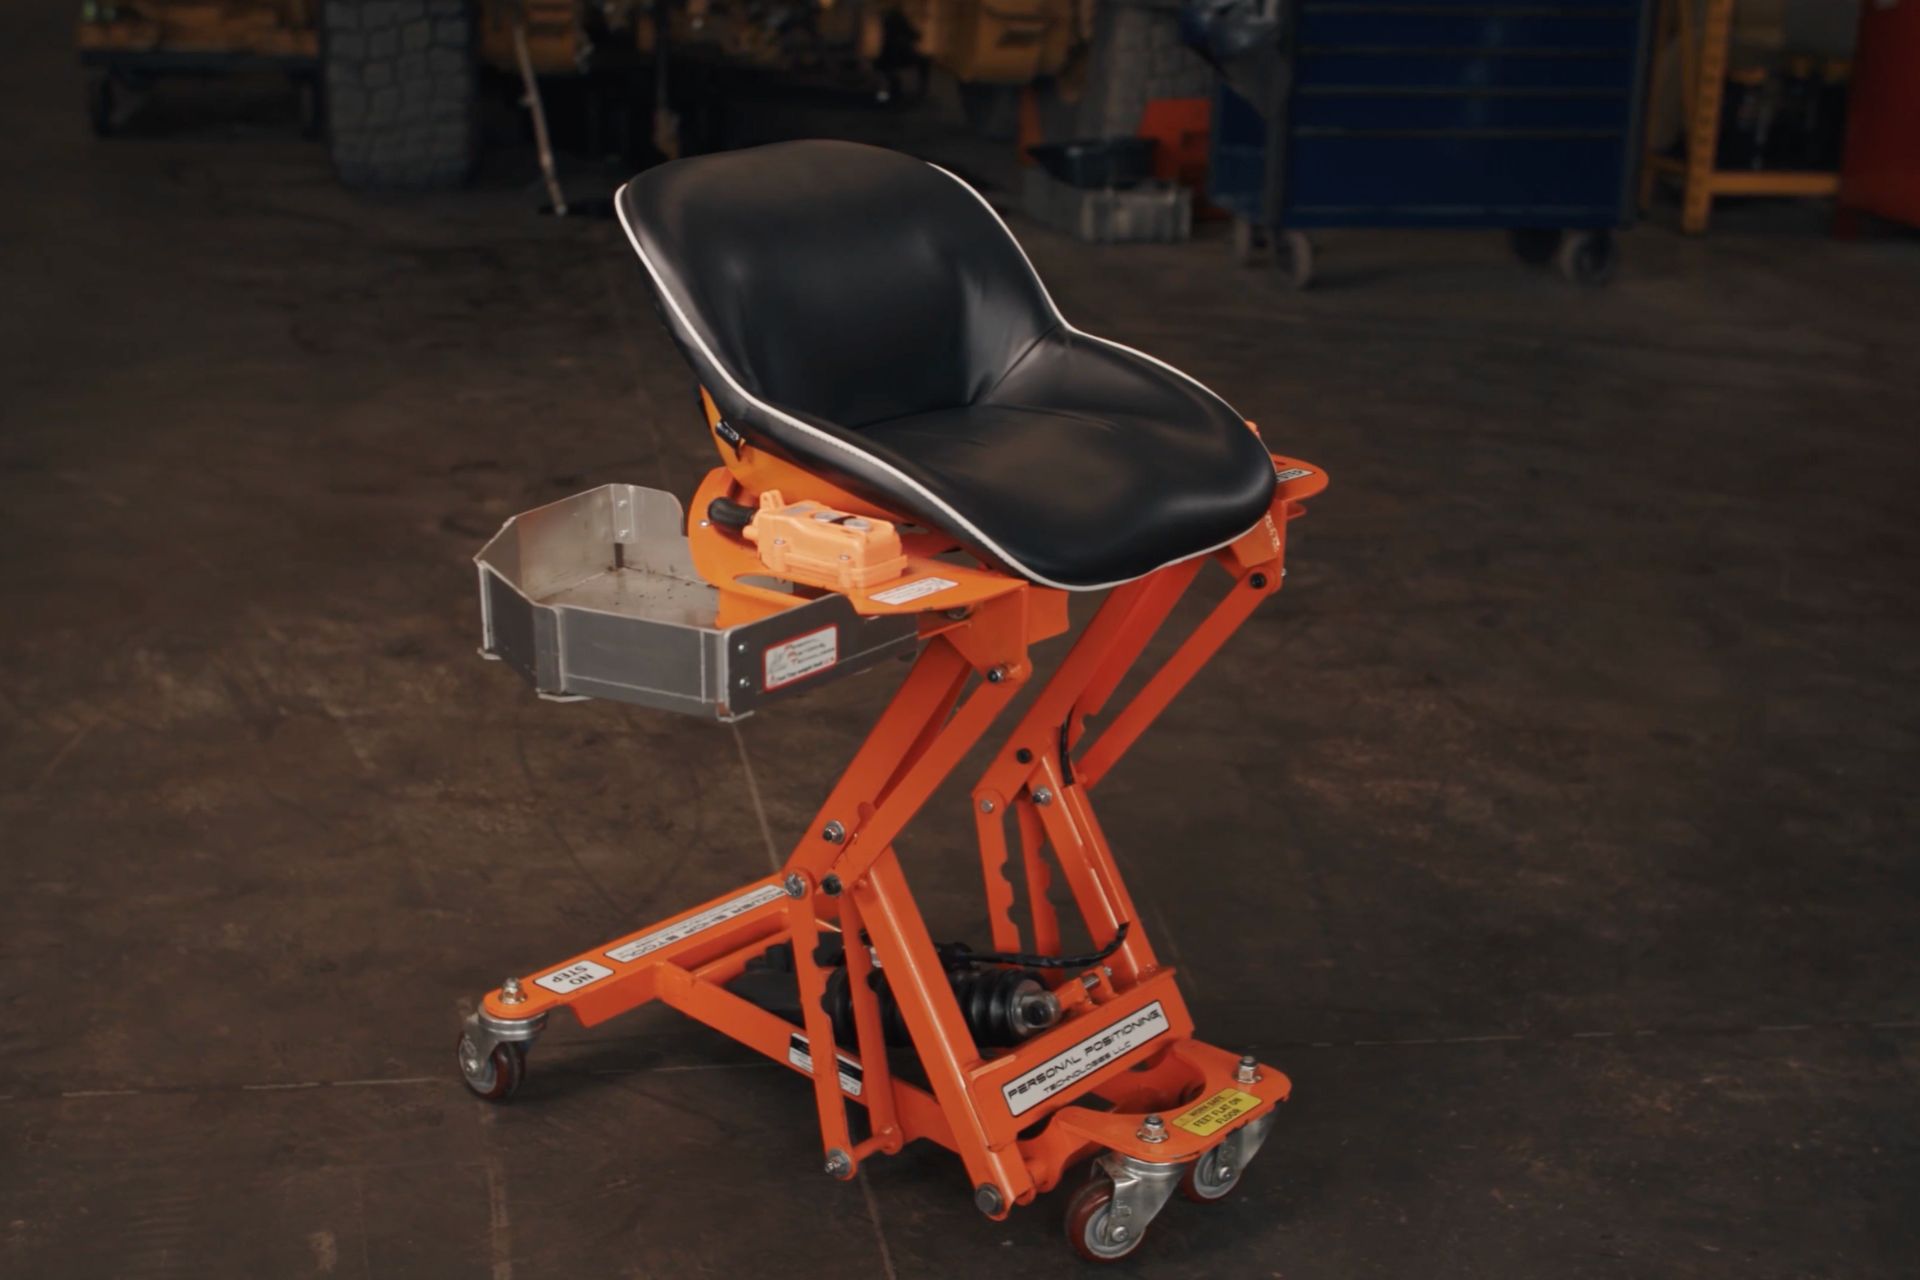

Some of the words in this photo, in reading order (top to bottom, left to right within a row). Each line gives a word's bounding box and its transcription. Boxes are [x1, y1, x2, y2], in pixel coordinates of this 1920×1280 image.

[552, 965, 588, 983] STEP
[569, 973, 595, 985] NO
[1007, 1056, 1082, 1099] PERSONAL
[1084, 1008, 1163, 1057] POSITIONING
[1113, 1041, 1132, 1056] LLC
[1193, 1114, 1212, 1127] FEET
[1211, 1103, 1228, 1116] FLAT
